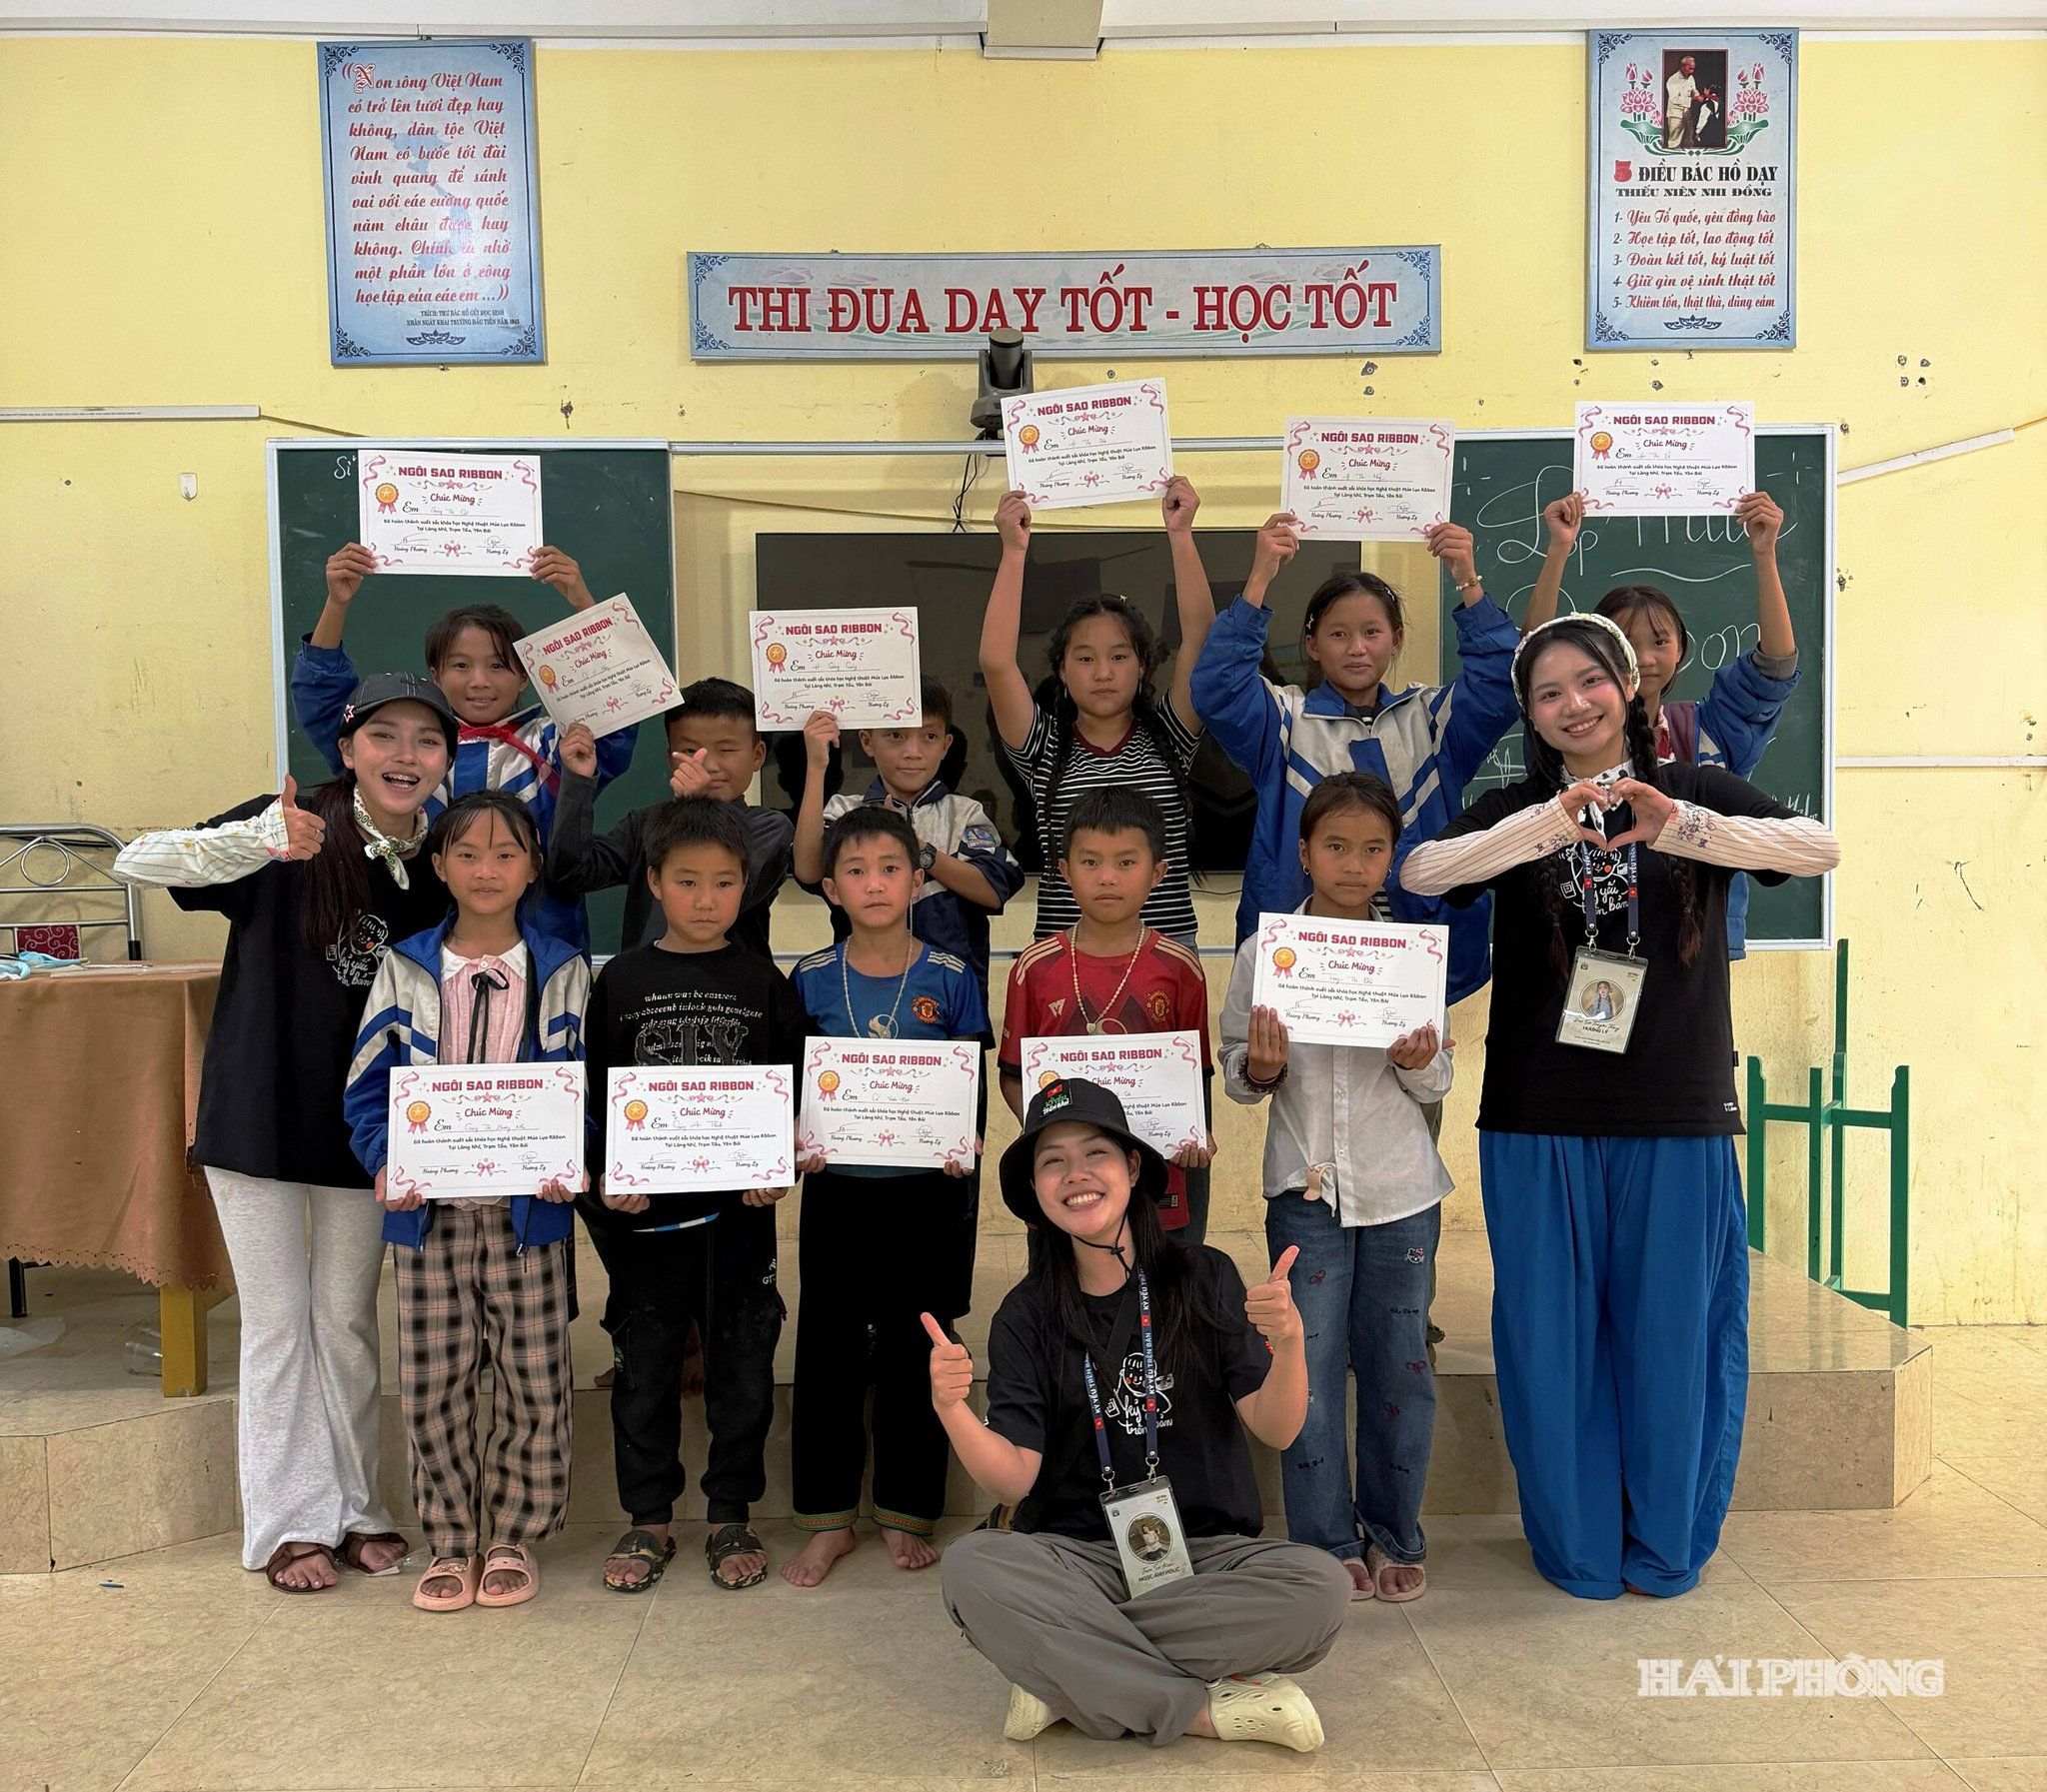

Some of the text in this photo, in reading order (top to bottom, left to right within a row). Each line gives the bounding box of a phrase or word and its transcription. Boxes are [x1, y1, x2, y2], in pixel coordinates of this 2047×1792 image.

[396, 73, 427, 91] sông
[431, 72, 462, 91] Việt
[466, 73, 503, 87] Nam
[348, 97, 503, 115] có trở lên tươi đẹp hay
[349, 120, 505, 139] không, dân tộc Việt
[350, 144, 506, 160] Nam có bước tới đài
[351, 166, 507, 187] vinh quang để sánh
[1614, 158, 1778, 185] 5 ĐIỀU BÁC HỒ DẠY
[1616, 185, 1658, 197] THIẾU
[1663, 187, 1697, 197] NIÊN
[1732, 184, 1772, 196] ĐỒNG
[353, 190, 509, 210] vai với các cường quốc
[353, 218, 385, 232] năm
[395, 217, 428, 231] châu
[481, 216, 509, 232] hay
[1627, 210, 1651, 226] Yêu
[1654, 207, 1671, 223] Tổ
[1672, 210, 1701, 225] quốc,
[1704, 212, 1723, 225] yêu
[1726, 208, 1753, 225] đồng
[1757, 210, 1775, 223] bào
[1628, 231, 1653, 247] Học
[1656, 232, 1677, 247] tập
[1680, 232, 1699, 246] tốt,
[1703, 231, 1721, 244] lao
[1725, 231, 1754, 247] động
[1758, 231, 1774, 244] tốt
[354, 241, 402, 258] không.
[411, 240, 452, 255] Chính
[483, 240, 511, 253] nhờ
[1627, 253, 1662, 266] Đoàn
[1666, 252, 1684, 266] kết
[1687, 251, 1707, 267] tốt,
[1730, 252, 1755, 268] luật
[1758, 252, 1775, 266] tốt
[355, 265, 382, 283] một
[389, 263, 426, 282] phần
[433, 264, 456, 278] lớn
[478, 267, 511, 279] công
[1626, 273, 1653, 290] Giữ
[1655, 275, 1676, 289] gìn
[1680, 276, 1694, 290] vệ
[1698, 274, 1724, 286] sinh
[1728, 274, 1755, 289] thật
[1758, 273, 1775, 286] tốt
[356, 289, 380, 306] học
[382, 290, 406, 306] tập
[408, 287, 433, 302] của
[435, 288, 457, 301] các
[728, 287, 812, 332] THI
[827, 288, 930, 334] ĐUA
[1060, 263, 1152, 333] TỐT
[1193, 284, 1291, 343] HỌC
[1304, 260, 1397, 329] TỐT
[1625, 295, 1659, 309] Khiêm
[1662, 293, 1681, 309] tốn,
[1683, 296, 1703, 311] thật
[1706, 295, 1724, 310] thà,
[1727, 295, 1752, 310] dũng
[1755, 295, 1775, 308] cảm
[1037, 397, 1131, 416] NGÔI SAO RIBBON
[1613, 415, 1641, 425] NGÔI
[1321, 431, 1418, 444] NGÔI SAO RIBBON
[399, 466, 502, 480] NGÔI SAO RIBBON
[786, 624, 882, 636] NGÔI SAO RIBBON
[1298, 931, 1406, 948] NGÔI SAO RIBBON
[842, 1052, 942, 1065] NGÔI SAO RIBBON
[1060, 1048, 1162, 1061] NGÔI SAO RIBBON
[432, 1079, 543, 1091] NGÔI SAO RIBBON
[649, 1080, 754, 1091] NGÔI SAO RIBBON
[464, 1107, 513, 1118] Chúc Mừng
[434, 1119, 452, 1131] Em
